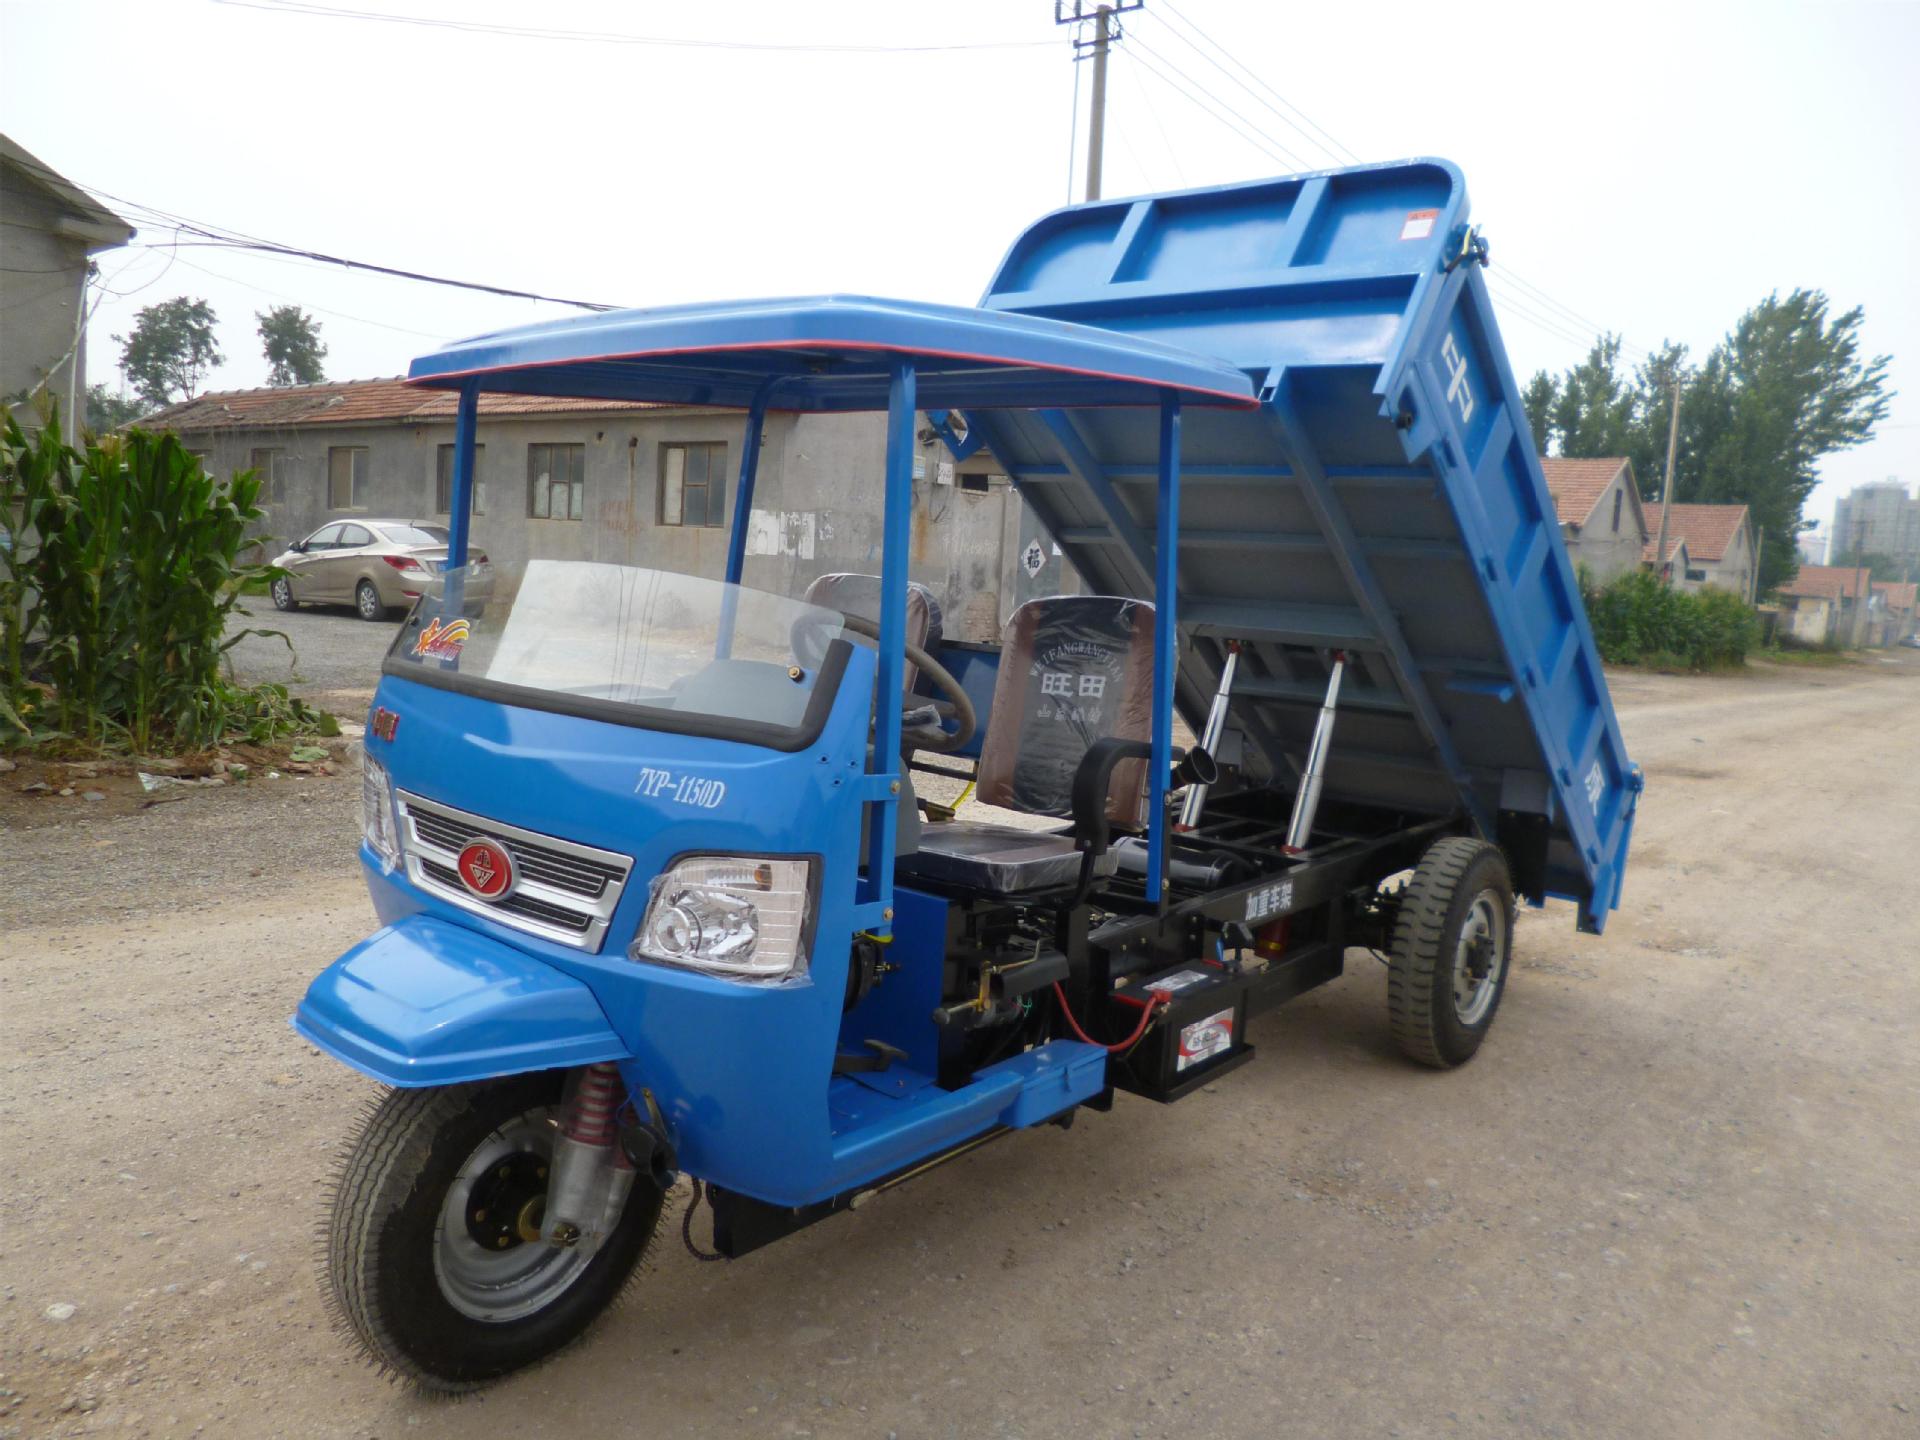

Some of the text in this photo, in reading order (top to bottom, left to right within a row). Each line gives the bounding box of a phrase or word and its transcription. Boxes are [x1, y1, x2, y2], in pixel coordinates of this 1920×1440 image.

[1027, 548, 1040, 569] 福
[1040, 672, 1106, 698] 旺田
[634, 767, 726, 809] 7YP-1150D
